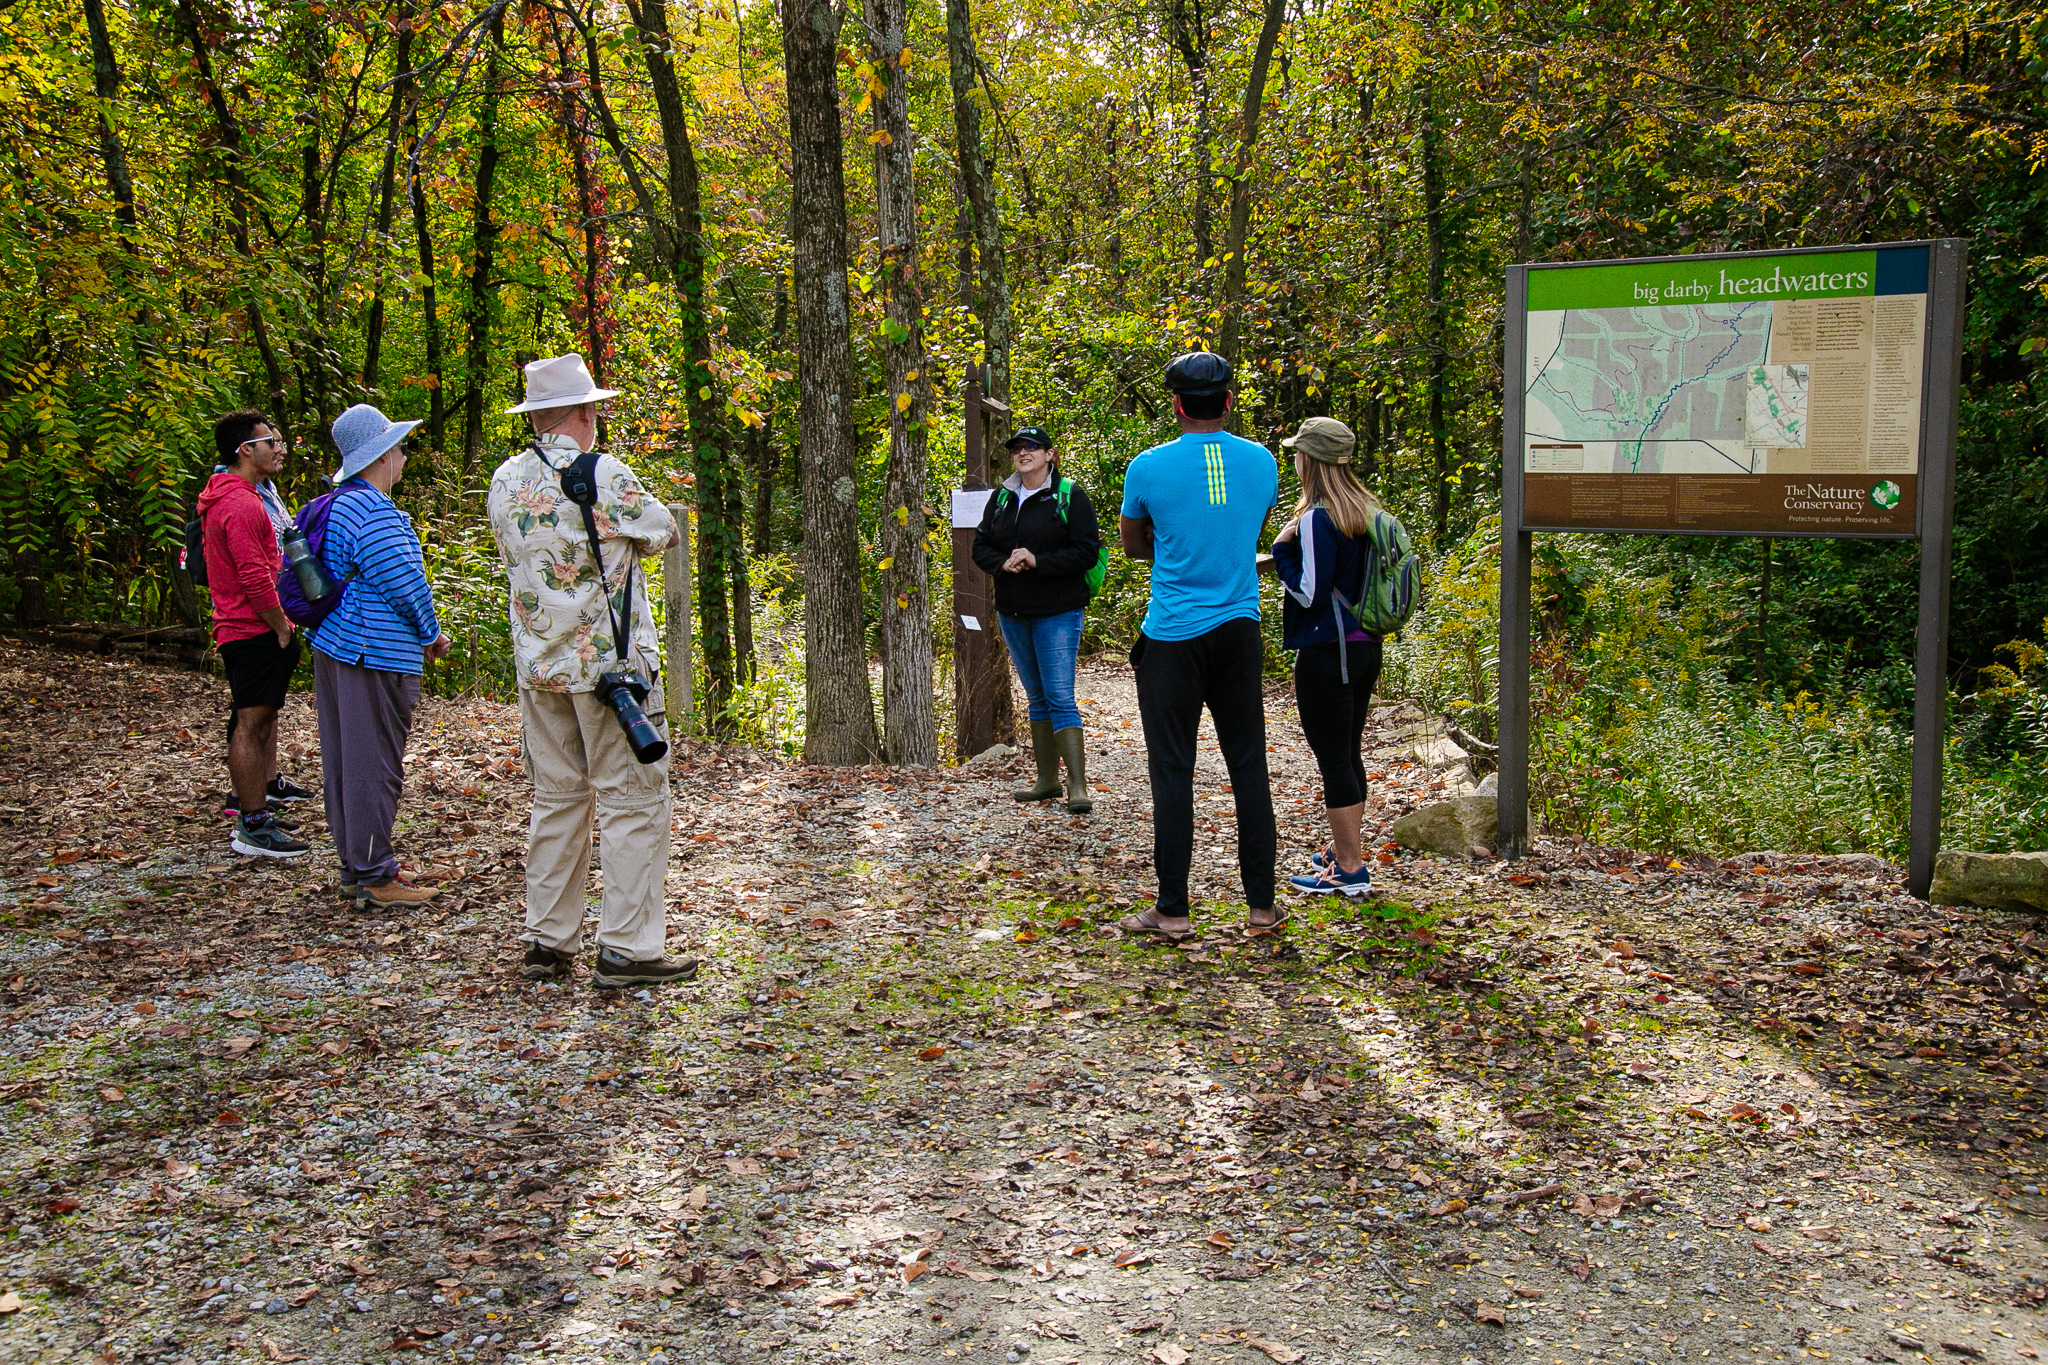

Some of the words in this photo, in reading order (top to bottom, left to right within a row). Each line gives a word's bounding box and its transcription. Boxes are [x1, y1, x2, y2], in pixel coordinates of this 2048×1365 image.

[1634, 282, 1659, 304] big
[1664, 279, 1713, 301] darby
[1718, 266, 1868, 295] headwaters
[1785, 485, 1806, 496] The
[1806, 484, 1866, 500] Nature
[1784, 497, 1865, 515] Conservancy
[1788, 516, 1820, 524] Protecting
[1846, 516, 1879, 525] Preserving
